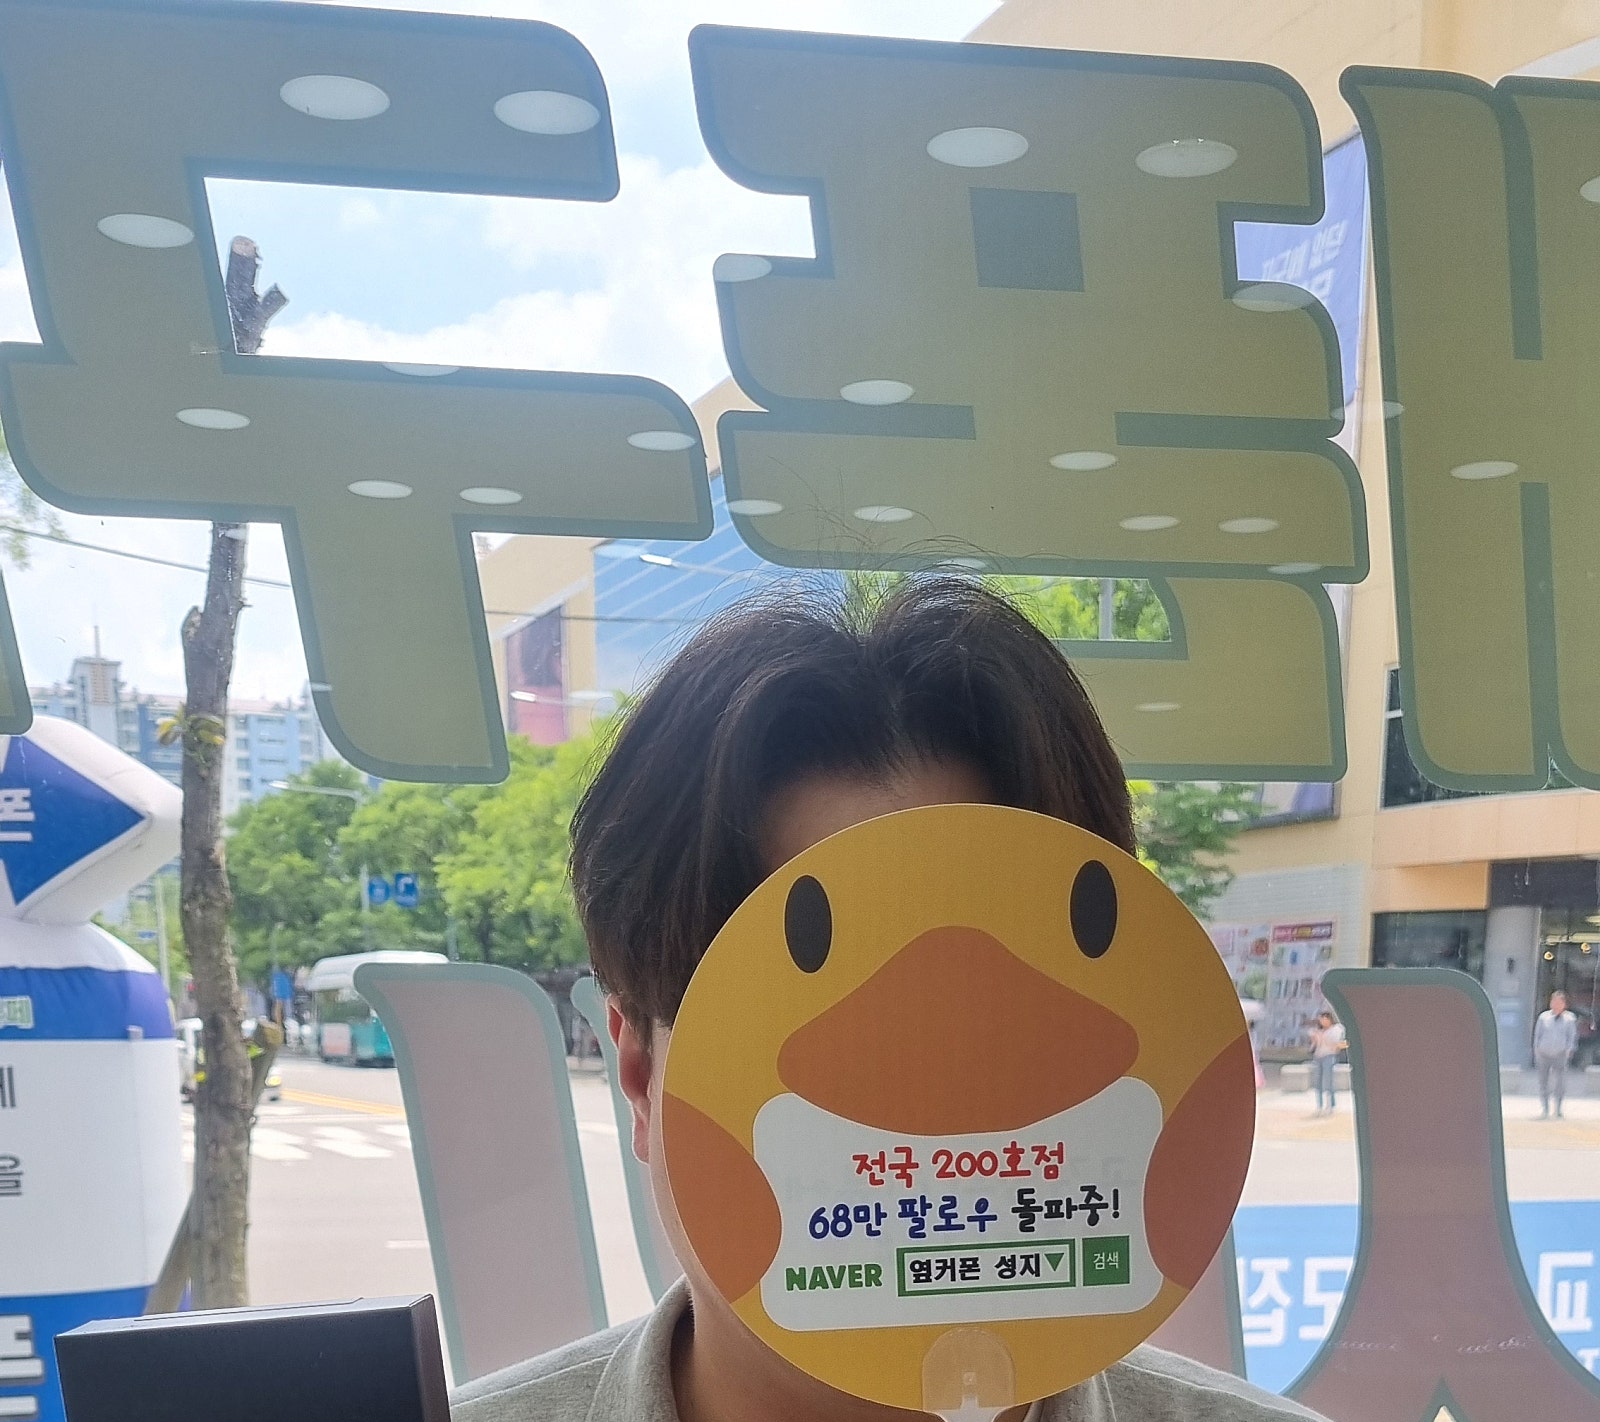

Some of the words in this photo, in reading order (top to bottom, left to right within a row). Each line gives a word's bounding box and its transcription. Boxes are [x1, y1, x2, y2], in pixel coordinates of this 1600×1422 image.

[852, 1146, 919, 1188] 전국
[931, 1139, 1065, 1180] 200호점
[808, 1201, 888, 1240] 68만
[897, 1194, 999, 1239] 팔로우
[1010, 1184, 1120, 1233] 돌파중!
[785, 1262, 883, 1292] NAVER
[908, 1257, 981, 1284] 옆커폰
[993, 1252, 1041, 1281] 성지
[1092, 1251, 1120, 1271] 검색
